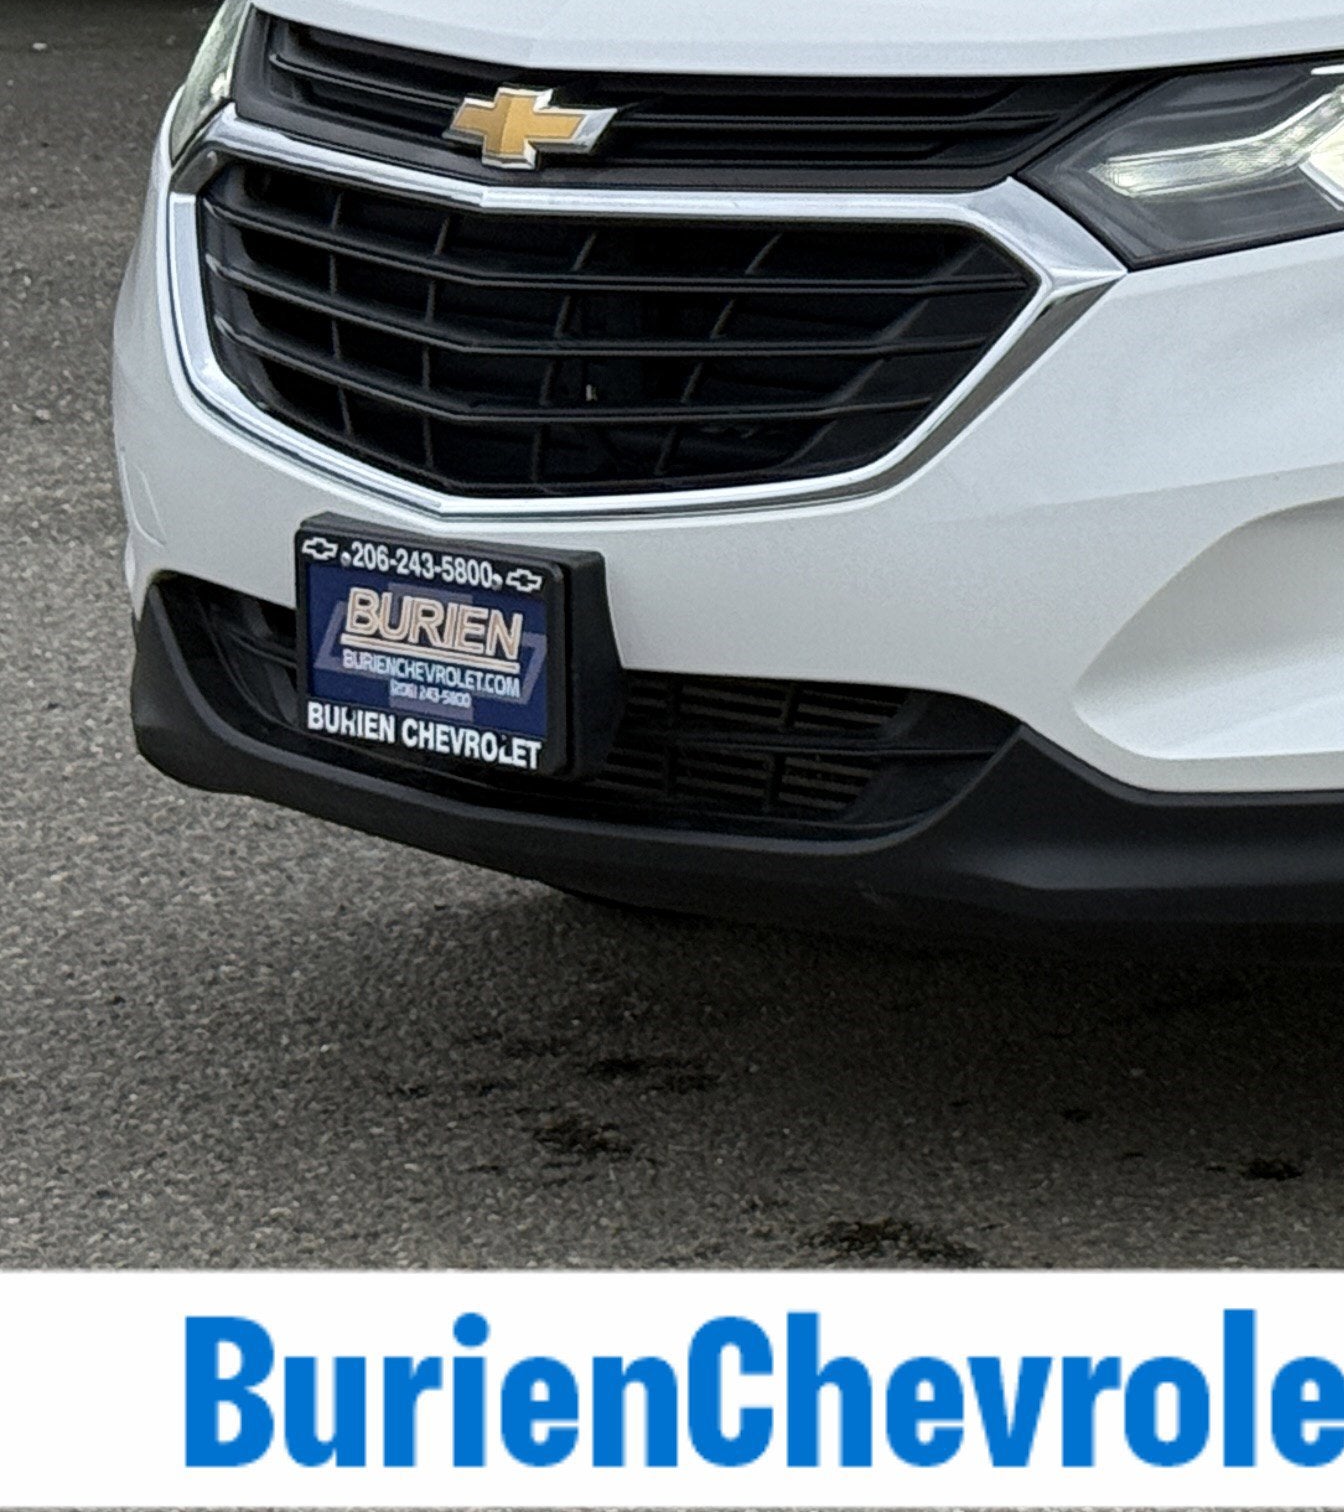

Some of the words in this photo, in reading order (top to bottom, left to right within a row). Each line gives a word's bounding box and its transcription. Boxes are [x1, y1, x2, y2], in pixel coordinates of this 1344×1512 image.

[352, 541, 492, 586] 206-243-5800
[345, 587, 523, 659] BURIEN
[343, 651, 520, 698] BURIENCHEVROLET.COM
[307, 701, 396, 744] BURIEN
[402, 717, 543, 770] CHEVROLET
